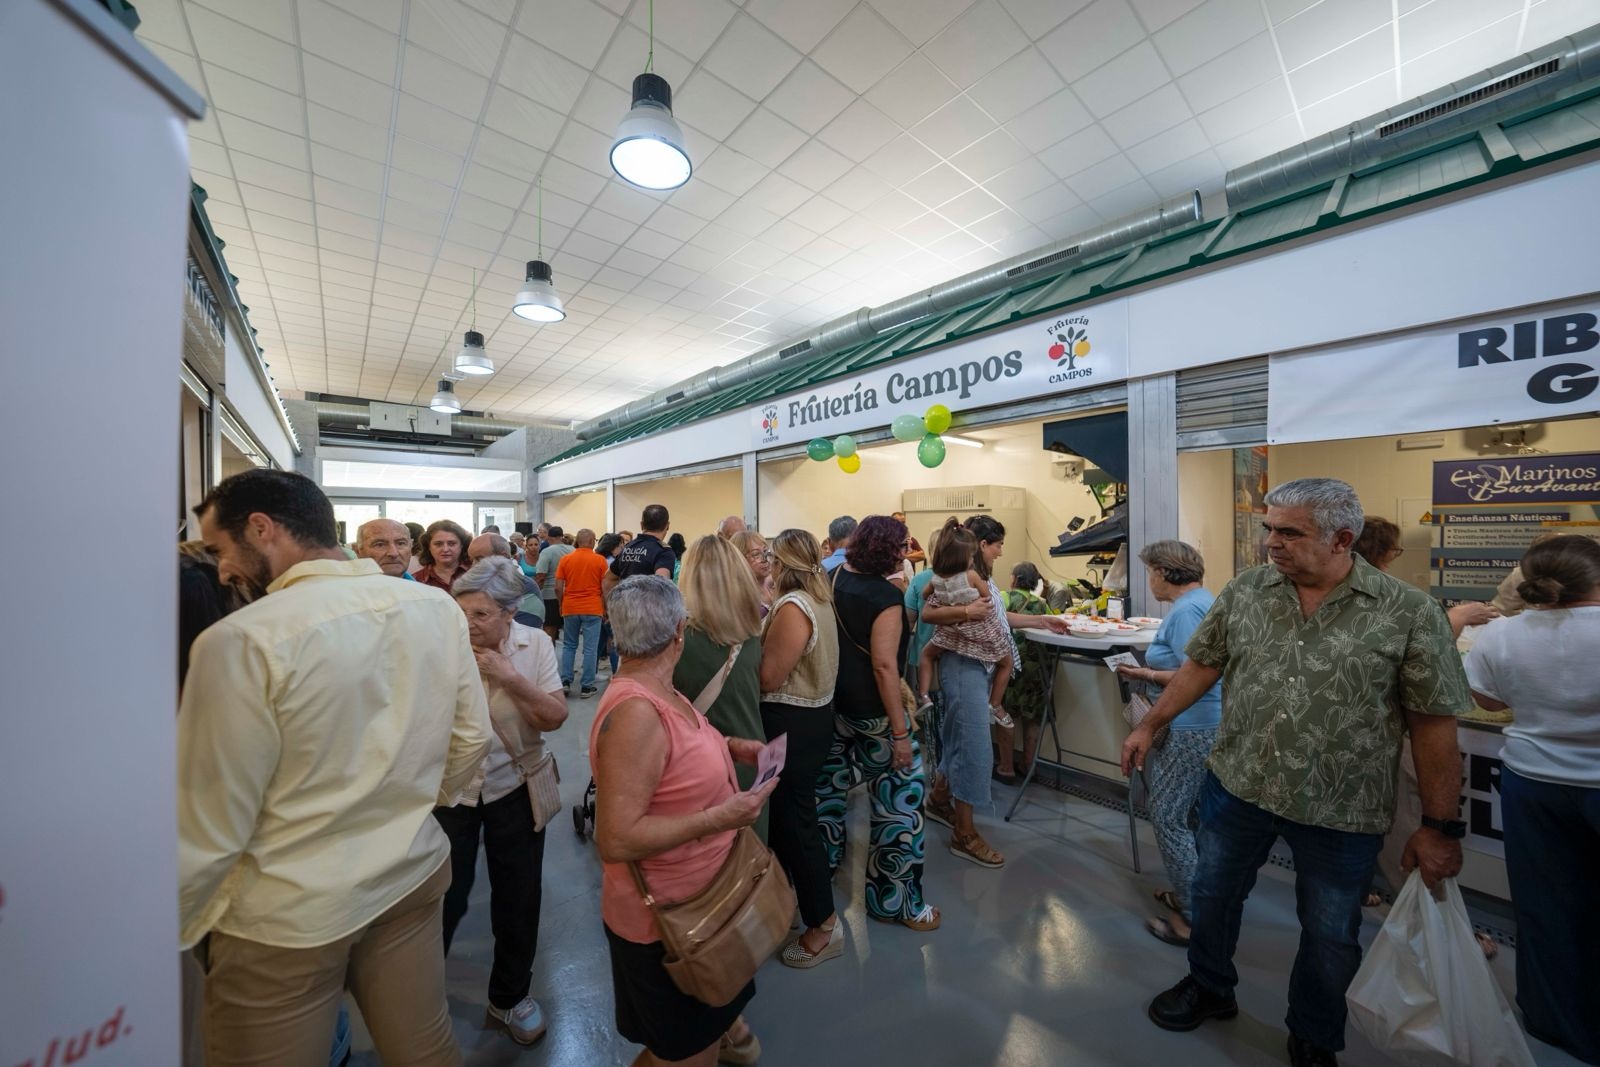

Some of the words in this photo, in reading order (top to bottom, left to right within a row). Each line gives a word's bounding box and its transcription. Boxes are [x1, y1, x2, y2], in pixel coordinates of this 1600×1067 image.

[1047, 316, 1089, 335] Frutería
[1458, 313, 1600, 368] RIB
[1049, 368, 1092, 383] CAMPOS
[1526, 363, 1600, 404] G
[788, 382, 878, 428] Frutería
[886, 350, 1023, 404] Campos
[1500, 464, 1597, 482] Marinos
[1448, 515, 1508, 523] Enseñanzas
[1510, 513, 1562, 522] Náuticas:
[623, 546, 647, 556] POLICÍA
[1448, 559, 1490, 567] Gestoría
[1492, 558, 1521, 567] Náuti
[12, 1005, 133, 1067] lud.
